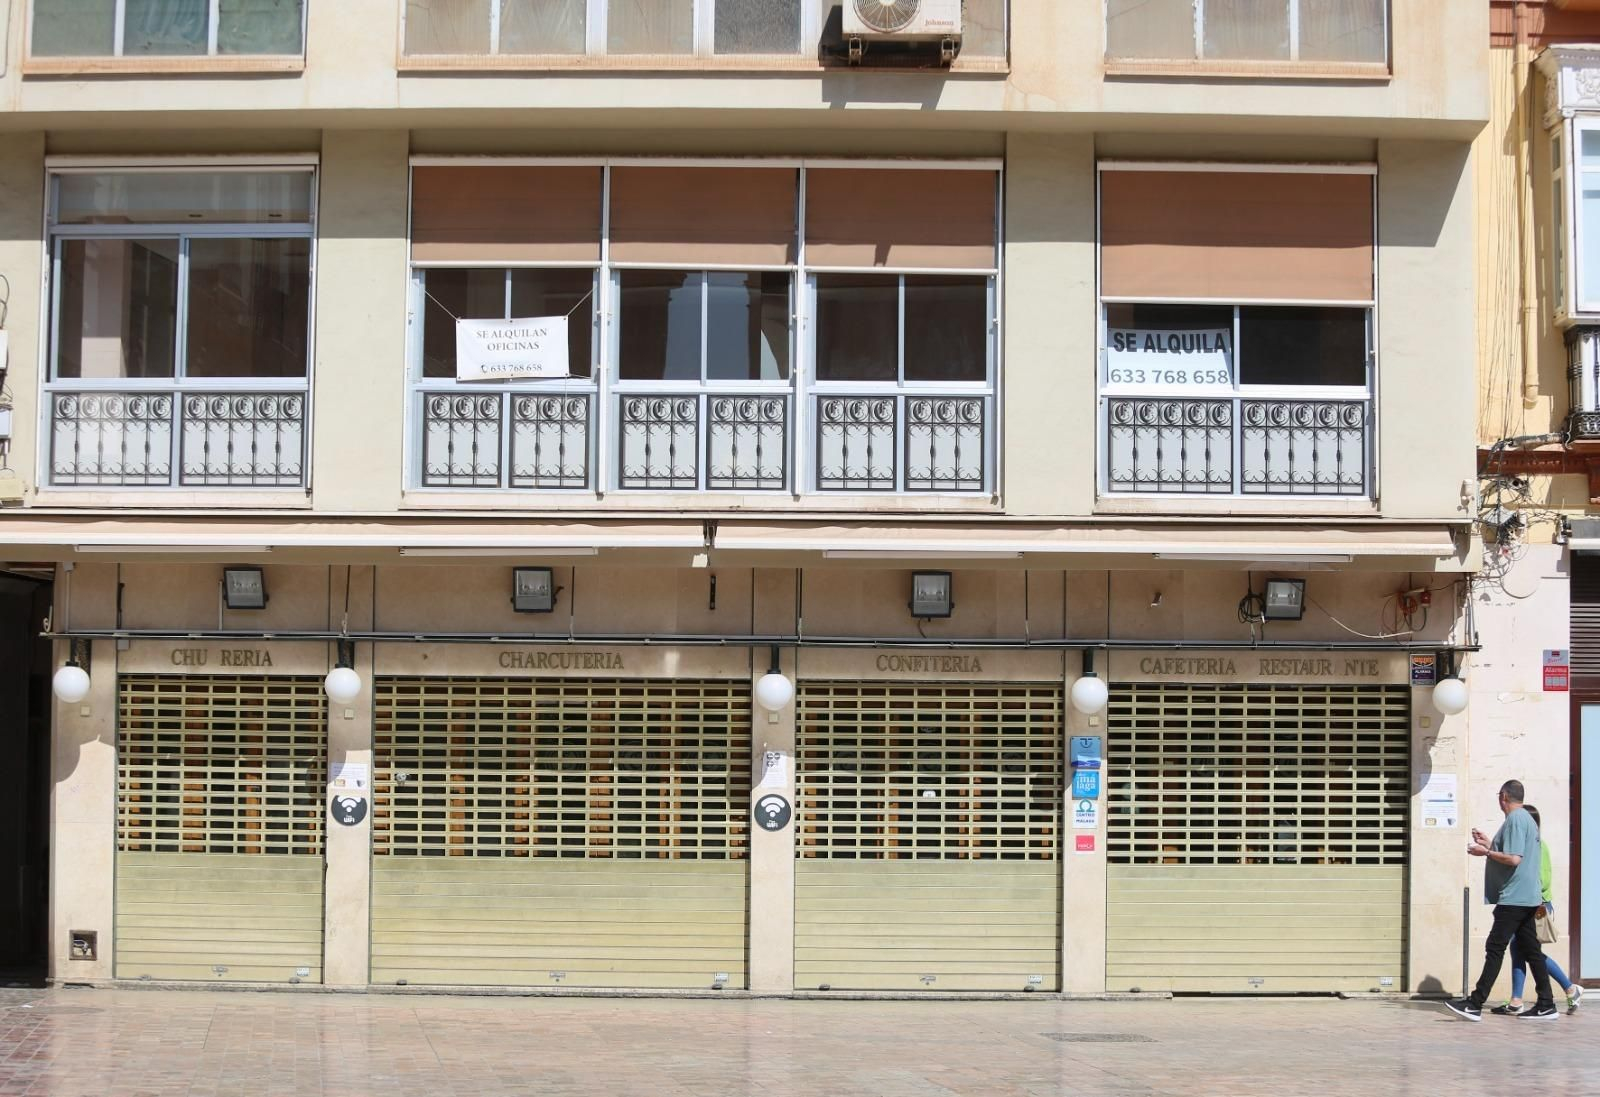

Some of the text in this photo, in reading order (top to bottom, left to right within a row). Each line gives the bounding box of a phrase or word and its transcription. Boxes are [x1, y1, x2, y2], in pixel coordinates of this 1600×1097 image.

[476, 328, 547, 339] SE ALQUILAN
[487, 341, 540, 351] OFICINAS
[1113, 332, 1227, 354] SE ALQUILA
[509, 364, 525, 373] 768
[526, 363, 543, 372] 658
[1110, 369, 1229, 384] 633 768 658
[171, 648, 273, 666] CHU RERIA
[498, 651, 624, 669] CHARCUTERIA
[876, 654, 983, 673] CONFITERIA
[1140, 657, 1237, 675] CAFETERIA
